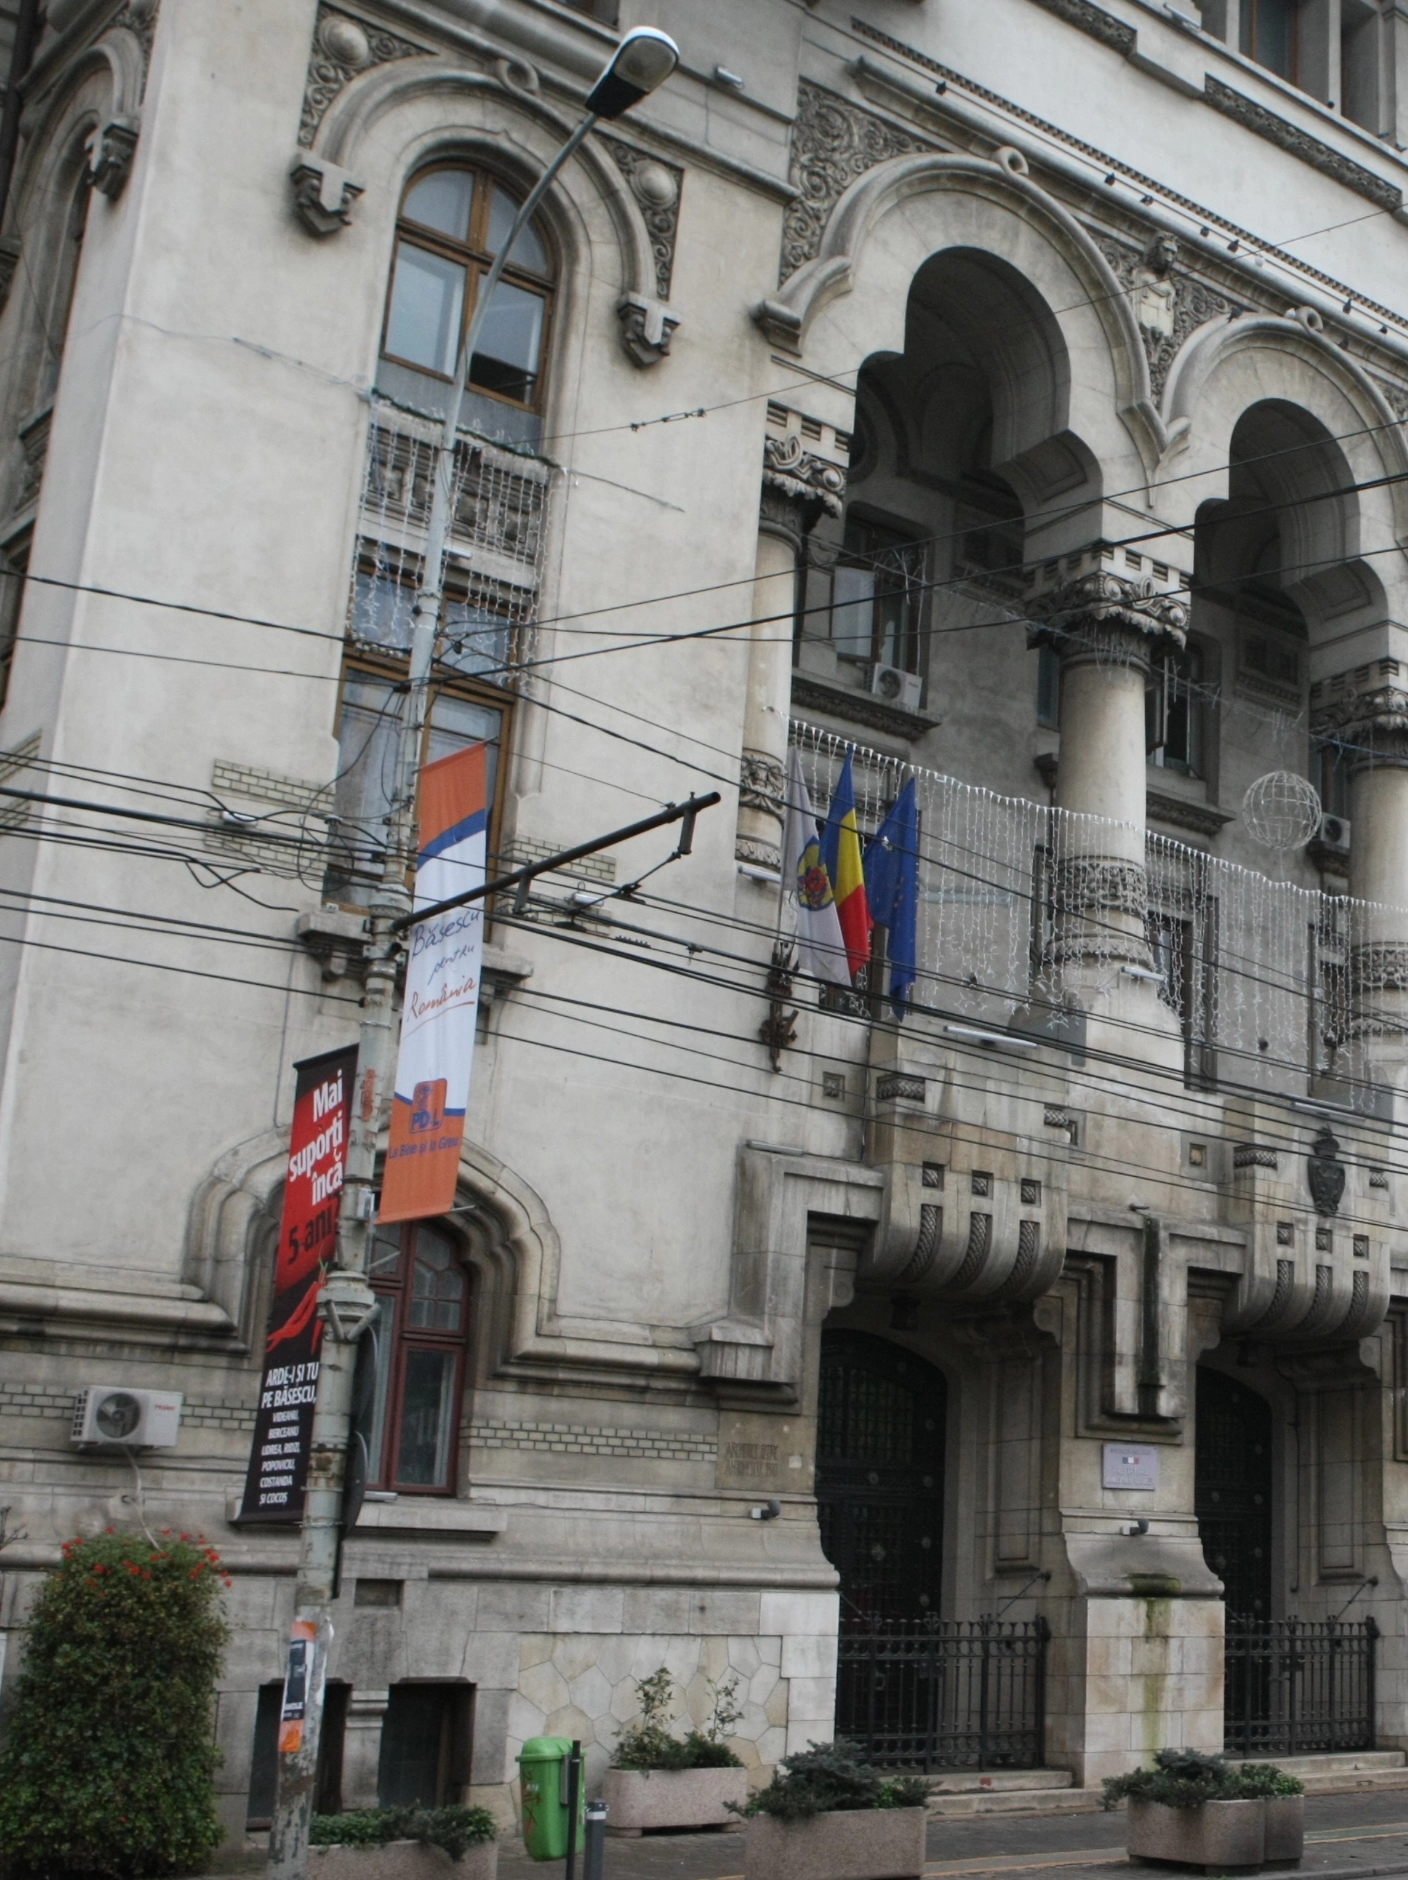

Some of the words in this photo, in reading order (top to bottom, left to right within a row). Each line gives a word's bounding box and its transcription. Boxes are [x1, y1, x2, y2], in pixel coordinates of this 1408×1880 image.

[412, 911, 480, 960] Băsescu
[407, 975, 476, 1022] România
[313, 1069, 343, 1123] Mai
[290, 1110, 343, 1182] suporți
[311, 1150, 343, 1206] încă
[287, 1225, 299, 1265] 5
[261, 1391, 275, 1409] PE
[273, 1385, 317, 1408] BĂSESCU,
[265, 1365, 296, 1388] ARDE-I
[307, 1362, 320, 1381] TU
